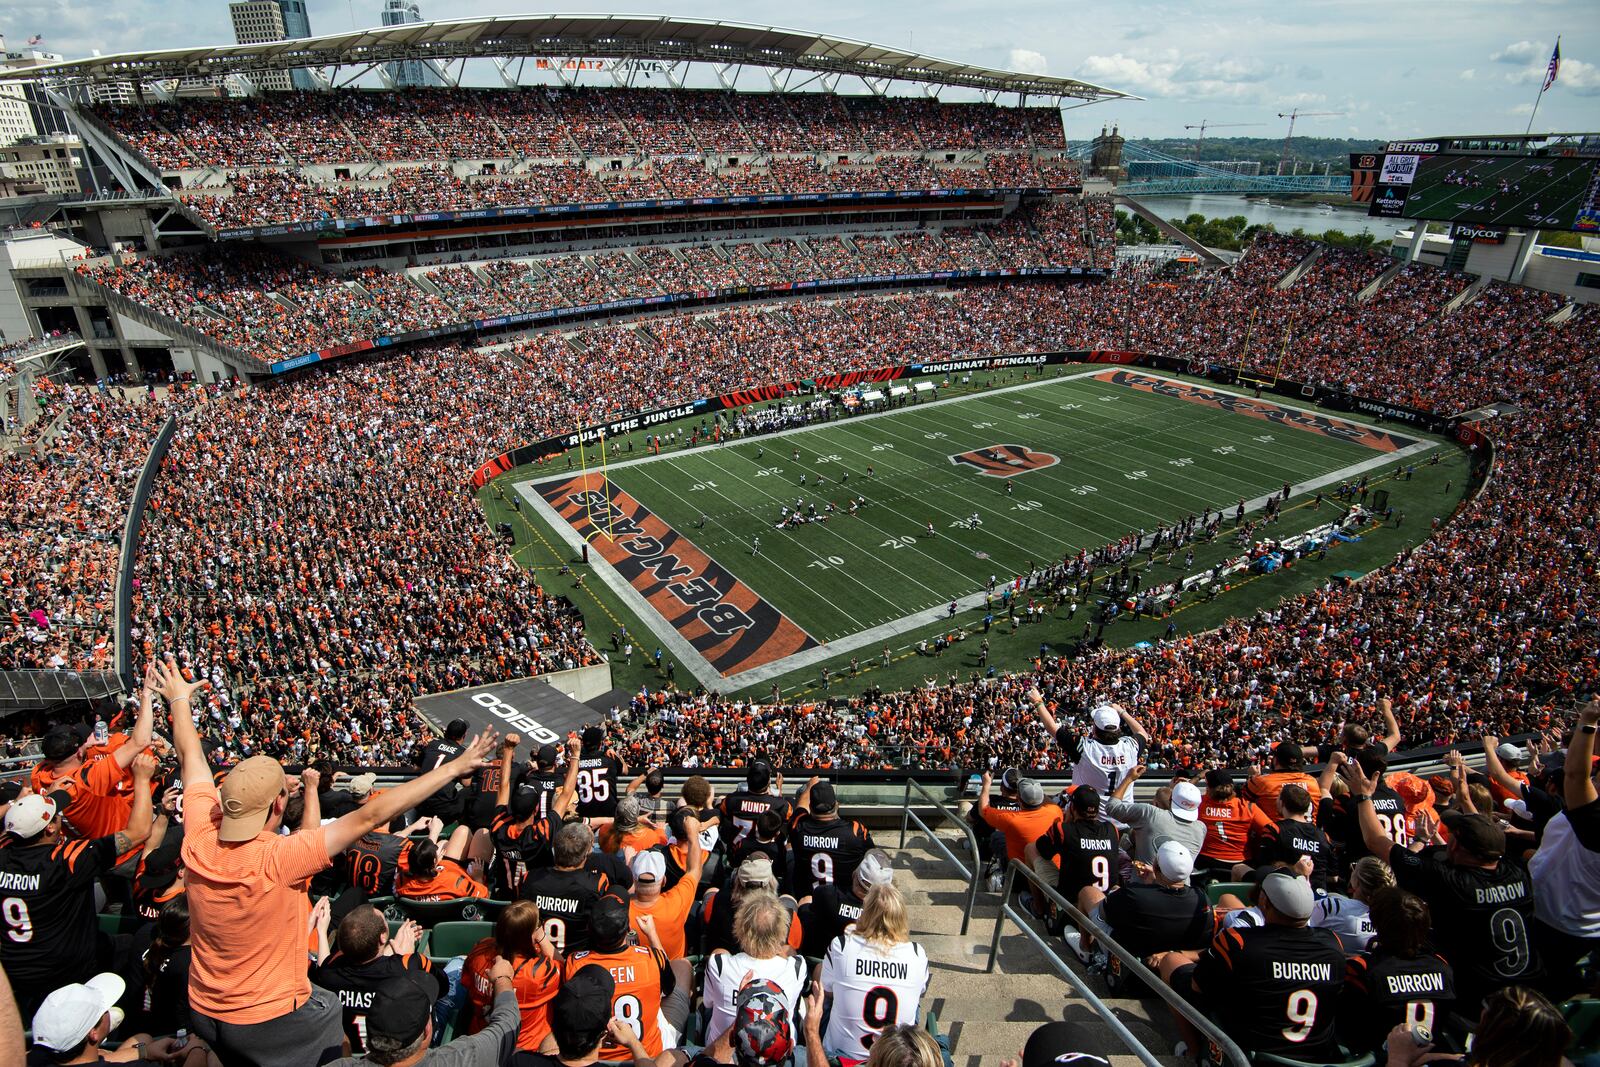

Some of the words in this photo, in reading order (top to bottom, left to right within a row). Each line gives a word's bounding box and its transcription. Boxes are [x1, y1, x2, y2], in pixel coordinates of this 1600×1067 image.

[1387, 142, 1440, 153] BETFRED
[1388, 164, 1396, 172] NO
[1390, 156, 1399, 164] ALL
[1375, 197, 1404, 206] Kettering
[1456, 225, 1502, 239] Paycor
[575, 304, 599, 312] CINCY.COM
[620, 298, 642, 306] CINCY.COM
[484, 318, 506, 326] BETFRED
[530, 311, 554, 319] CINCY.COM
[284, 361, 296, 369] BUD
[296, 356, 310, 364] LIGHT
[921, 360, 990, 374] CINCINNATI
[993, 355, 1047, 366] BENGALS
[1124, 377, 1368, 438] BENGALS
[1358, 401, 1385, 413] WHO
[1387, 408, 1416, 421] DEY!
[569, 427, 606, 445] RULE
[611, 418, 639, 433] THE
[643, 405, 694, 425] JUNGLE
[1070, 485, 1097, 495] 50
[1016, 501, 1043, 511] 40
[884, 536, 916, 549] 20
[566, 490, 756, 635] BENGALS
[814, 556, 844, 570] 10
[471, 693, 560, 744] GEICO
[437, 743, 458, 755] CHASE
[1101, 755, 1125, 766] CHASE
[577, 768, 610, 803] 85
[1105, 771, 1118, 796] 1
[540, 790, 548, 819] 1
[1205, 806, 1231, 818] CHASE
[1215, 821, 1228, 841] 1
[803, 835, 839, 849] BURROW
[1080, 839, 1111, 850] BURROW
[1292, 837, 1320, 853] CHASE
[350, 848, 381, 894] 18
[811, 853, 834, 885] 9
[1092, 855, 1109, 892] 9
[0, 872, 40, 891] URROW
[1475, 883, 1526, 904] BURROW
[536, 895, 579, 913] BURROW
[2, 897, 33, 943] 9
[543, 918, 566, 952] 9
[1490, 907, 1529, 978] 9
[856, 959, 908, 981] BURROW
[1273, 961, 1331, 981] BURROW
[1387, 973, 1444, 994] BURROW
[339, 990, 376, 1008] CHAS
[862, 986, 899, 1051] 9
[1282, 989, 1318, 1043] 9
[353, 1014, 370, 1055] 1
